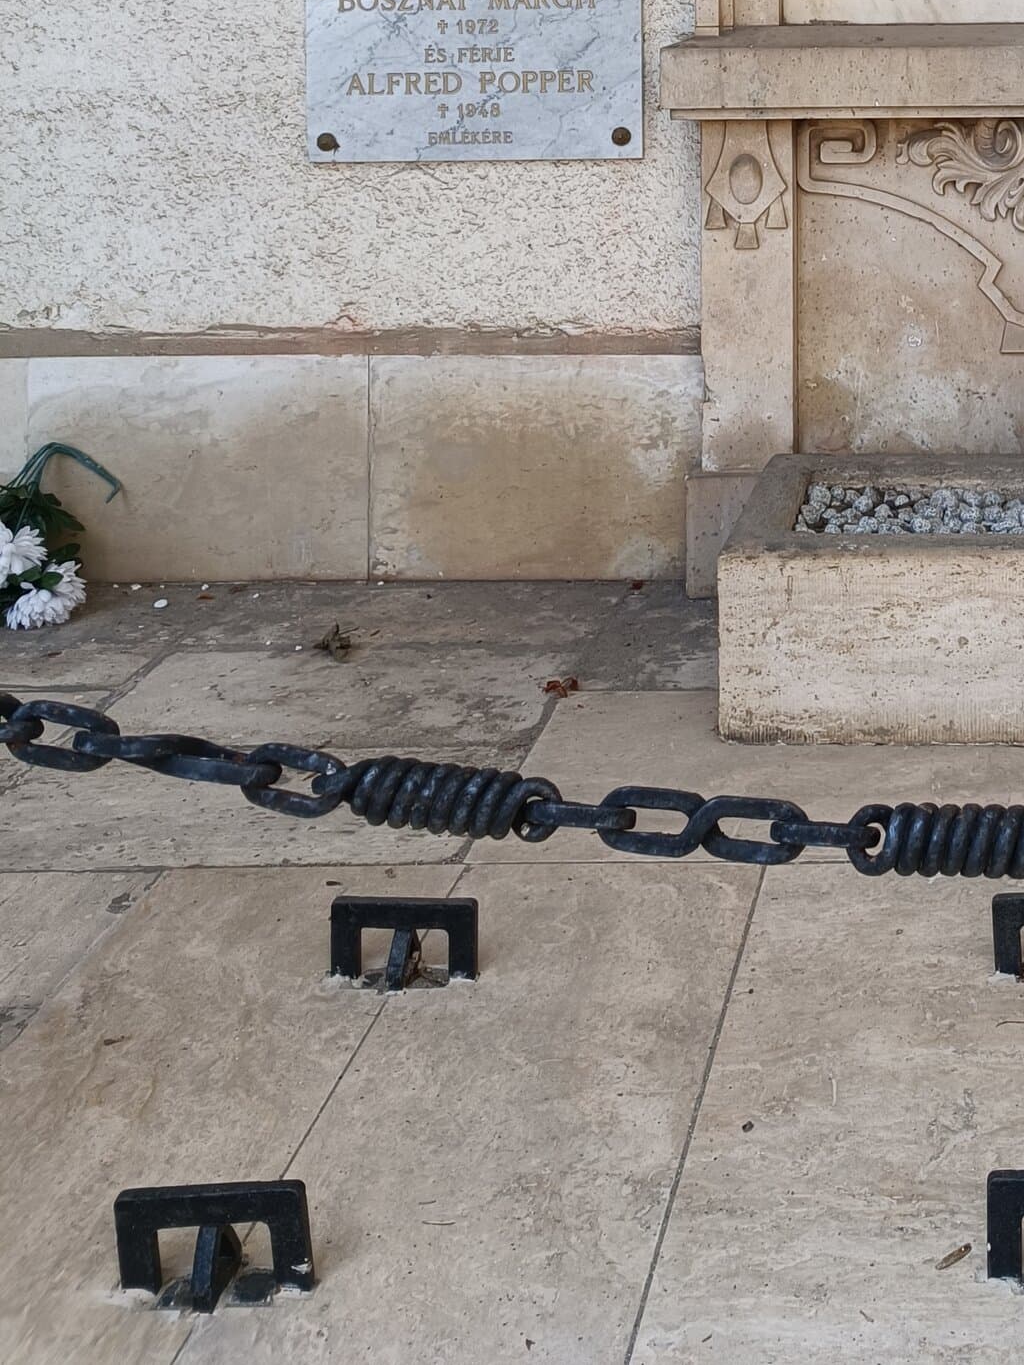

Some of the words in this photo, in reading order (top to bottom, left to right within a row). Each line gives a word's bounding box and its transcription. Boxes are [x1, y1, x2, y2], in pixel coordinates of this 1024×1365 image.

[457, 19, 499, 34] 1972
[425, 45, 447, 63] ÉS
[458, 44, 515, 63] FÉRJE
[347, 72, 462, 95] ALFRED
[480, 70, 594, 94] POPPER
[458, 103, 501, 118] 1948
[428, 130, 513, 146] EMLÉKÉRE
